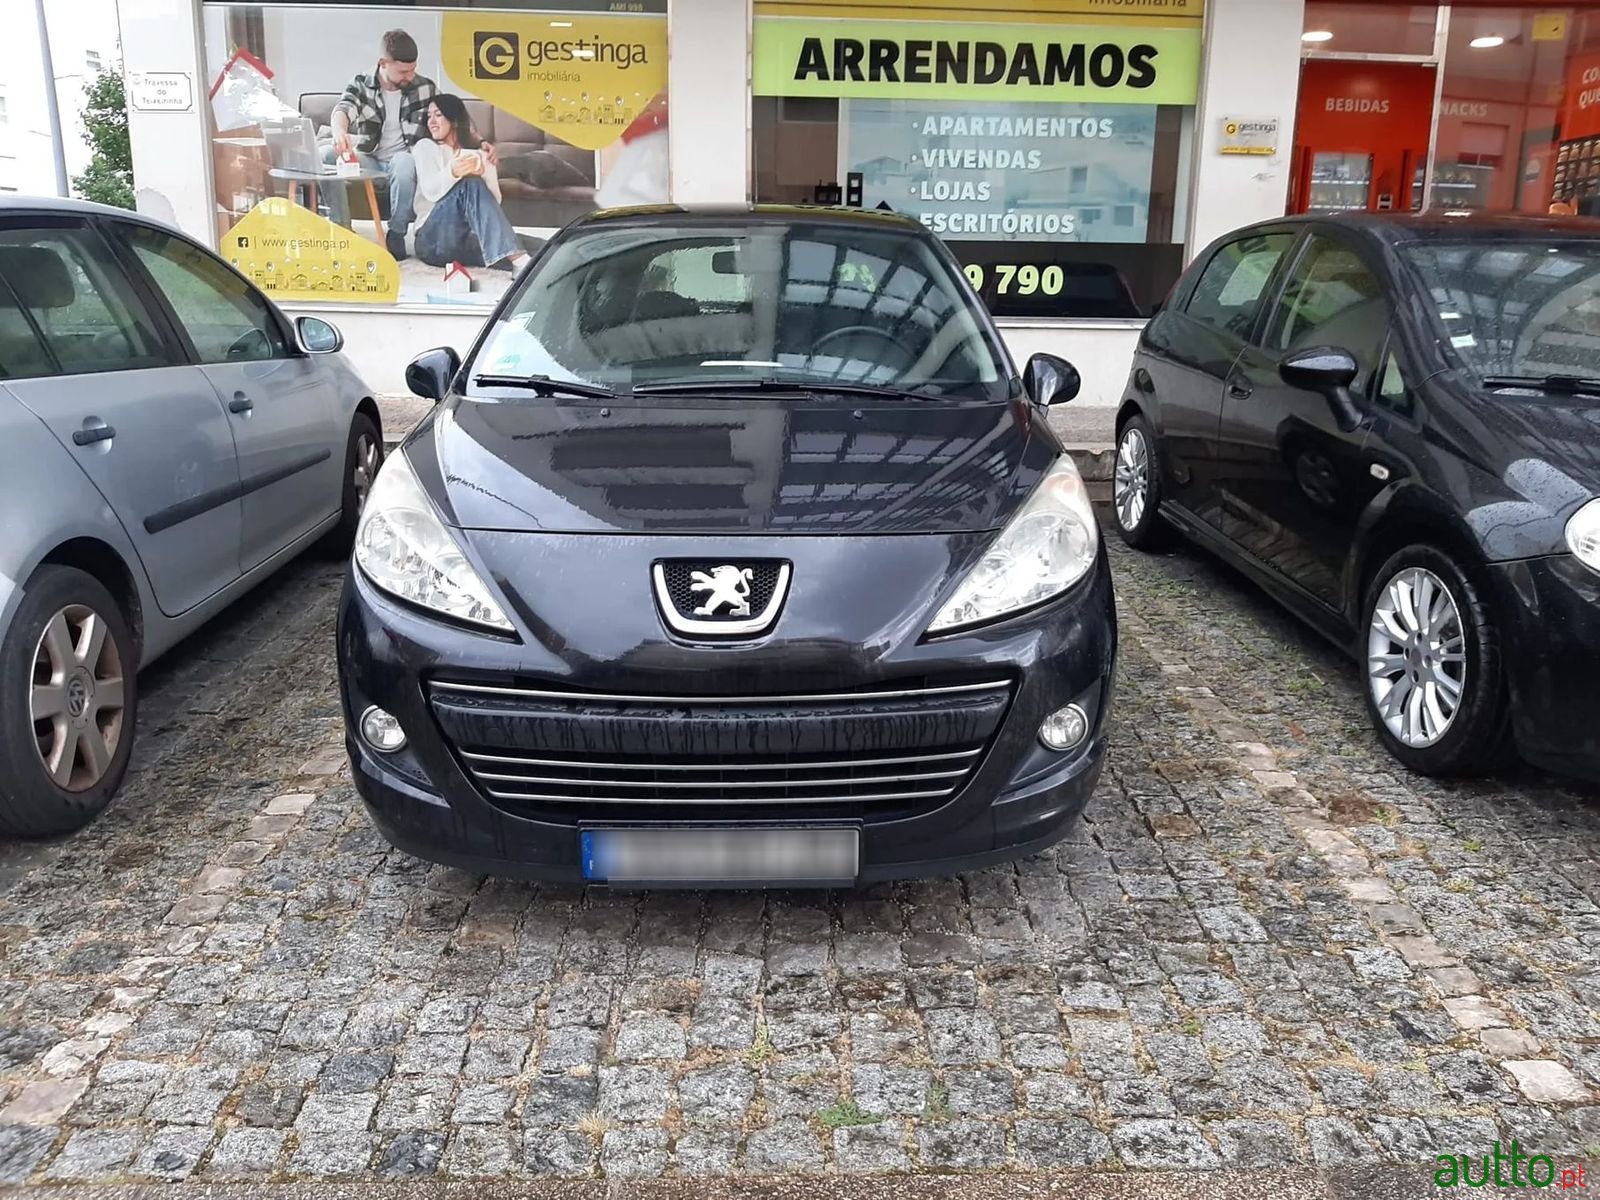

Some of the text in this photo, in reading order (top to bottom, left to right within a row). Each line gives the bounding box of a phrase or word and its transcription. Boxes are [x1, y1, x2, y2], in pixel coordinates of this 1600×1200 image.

[527, 35, 648, 70] gestinga
[794, 38, 1159, 89] ARRENDAMOS
[527, 70, 581, 83] imobiliária
[1325, 98, 1390, 113] BEBIDAS
[1439, 102, 1488, 117] NACKS
[922, 116, 1113, 138] APARTAMENTOS
[921, 148, 1041, 170] VIVENDAS
[920, 180, 991, 201] LOJAS
[919, 208, 1075, 234] ESCRITÓRIOS
[262, 237, 350, 251] www.gestinga.pt
[995, 264, 1064, 295] 790
